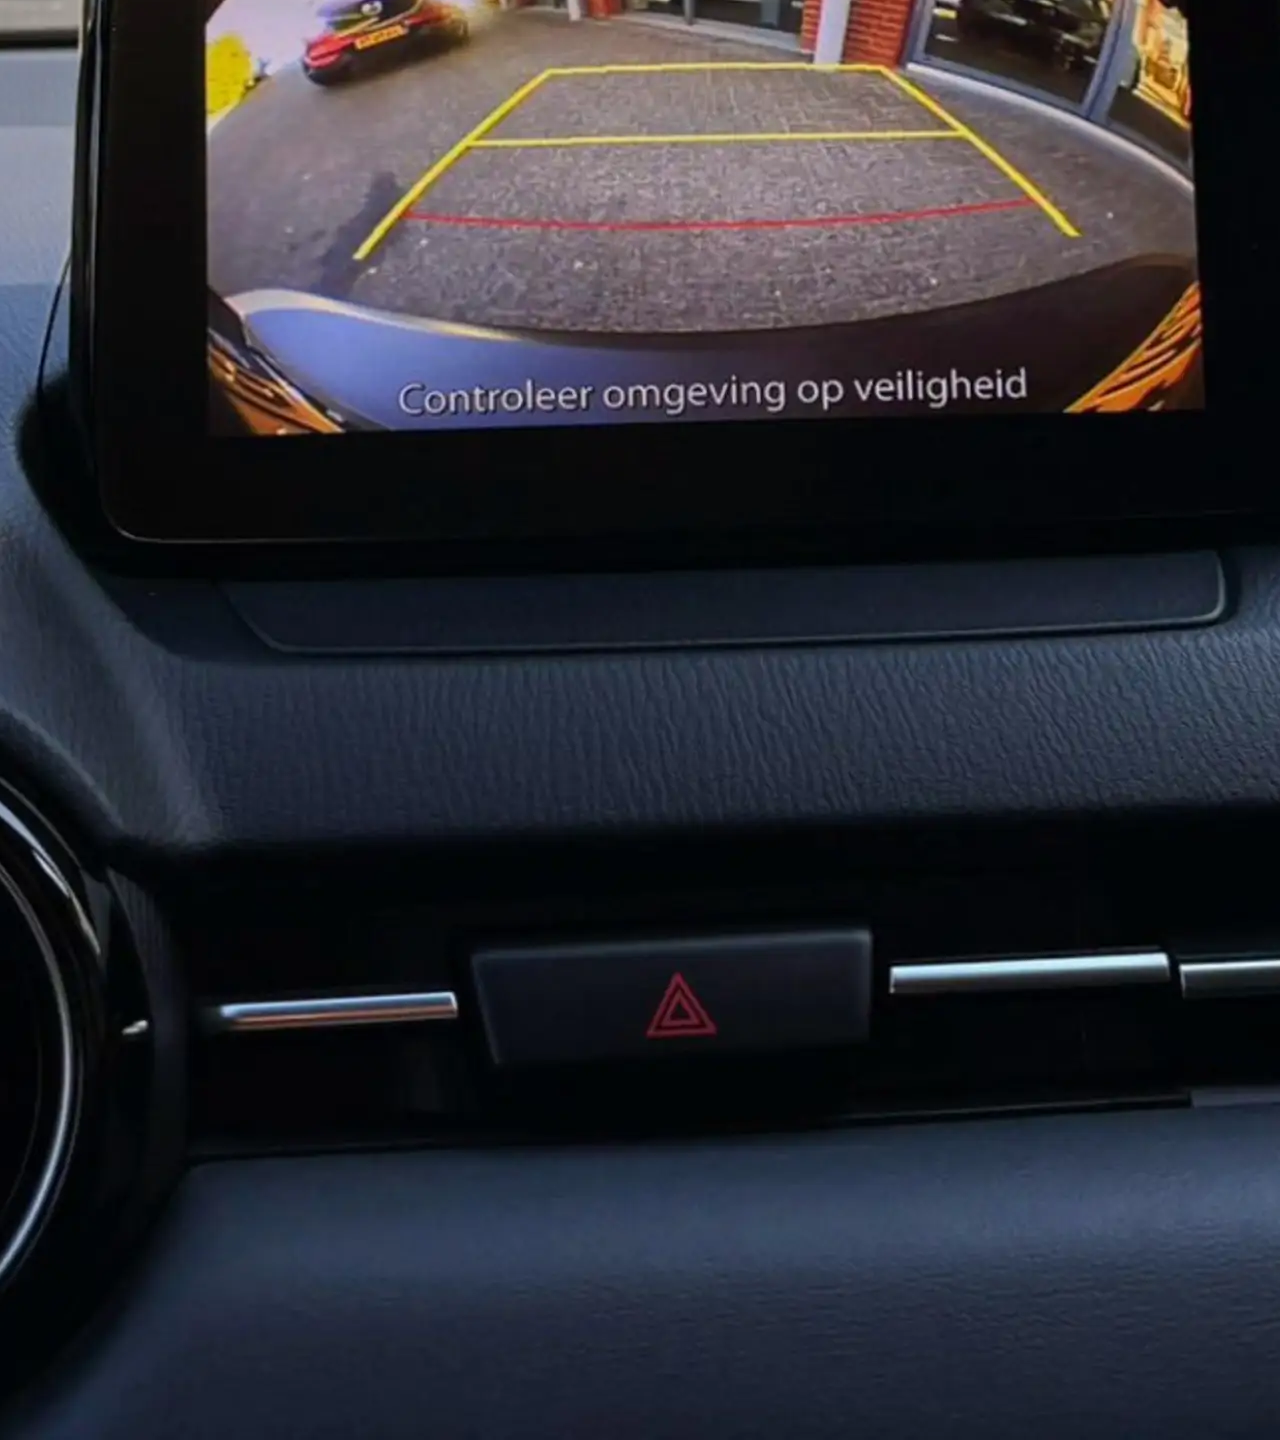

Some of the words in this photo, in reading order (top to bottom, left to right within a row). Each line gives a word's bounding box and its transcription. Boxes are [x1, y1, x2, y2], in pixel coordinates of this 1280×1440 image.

[398, 379, 592, 417] Controleer
[603, 374, 787, 416] omgeving
[797, 378, 845, 412] op
[854, 367, 1029, 408] veiligheid
